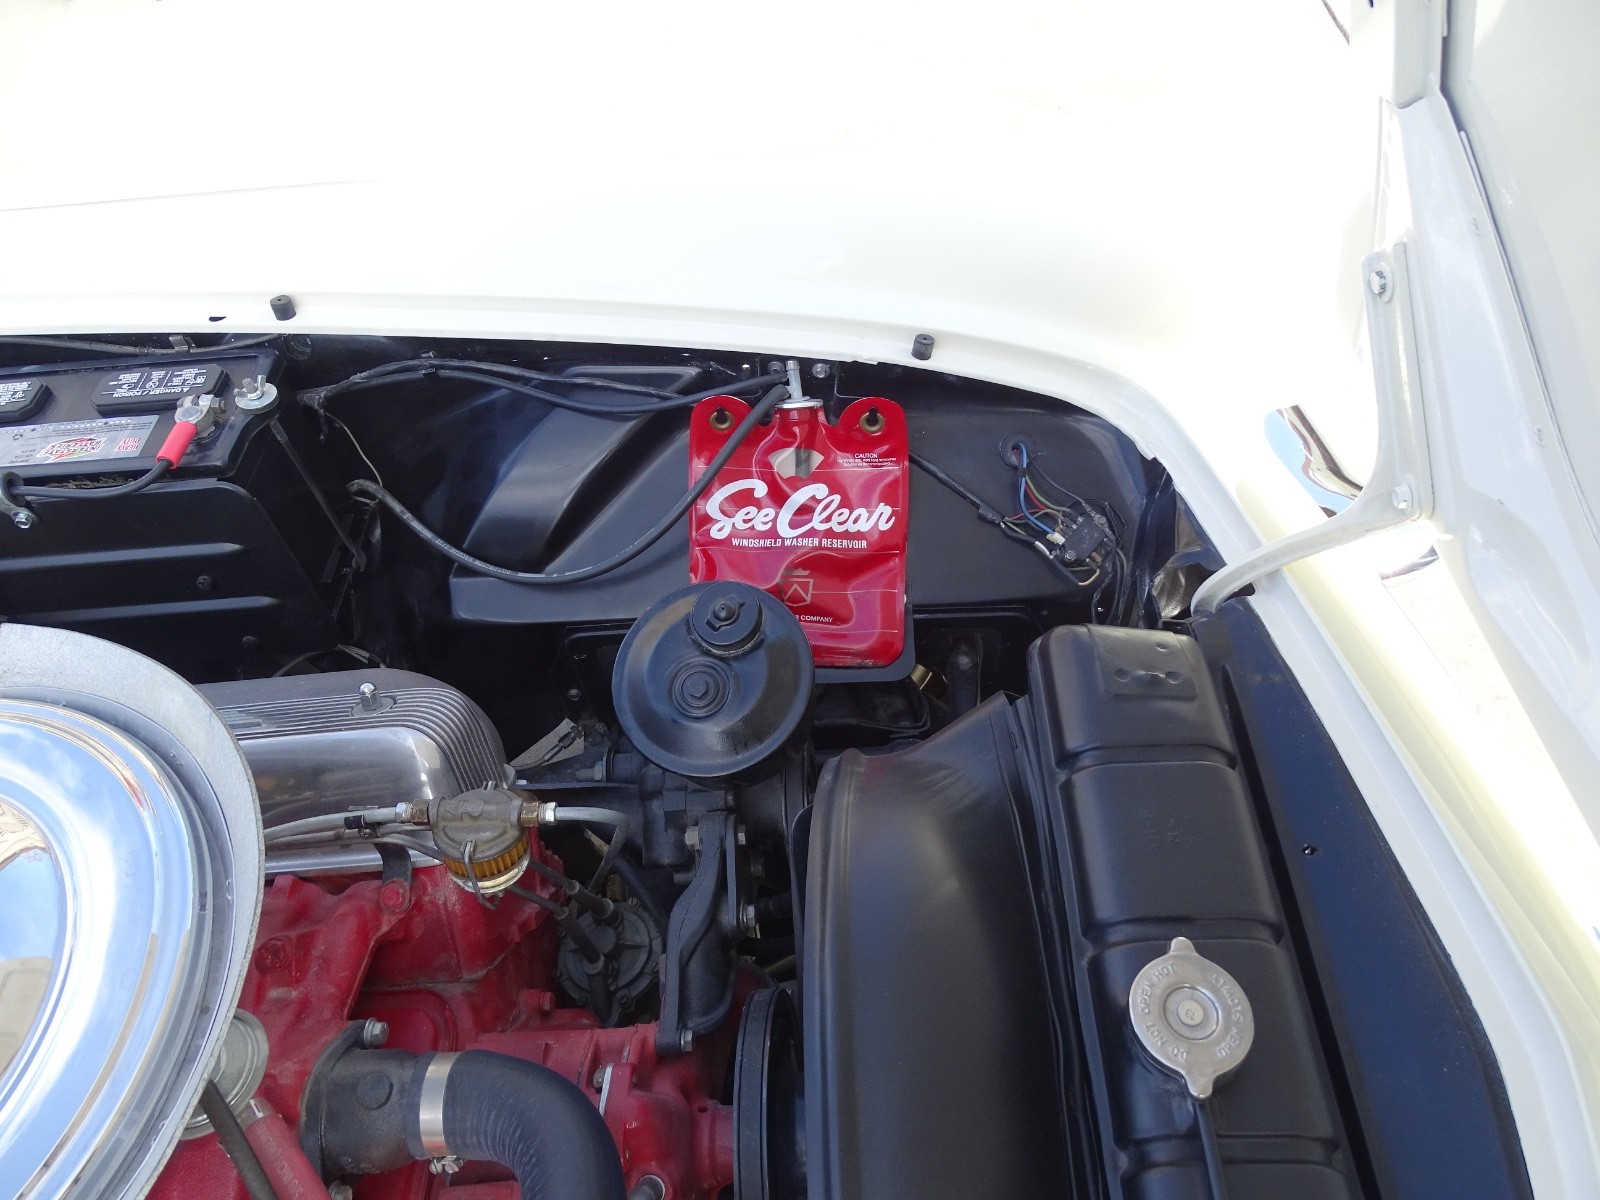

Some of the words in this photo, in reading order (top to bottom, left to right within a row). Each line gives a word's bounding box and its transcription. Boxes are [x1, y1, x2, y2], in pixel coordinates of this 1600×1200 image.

[45, 445, 101, 455] INTERSTATE
[706, 478, 775, 539] See
[776, 483, 895, 538] Clear
[731, 537, 782, 548] WINDSHIELD
[784, 537, 819, 547] WASHER
[821, 538, 867, 549] RESERVOIR
[1154, 961, 1176, 982] HOT
[1139, 982, 1155, 1016] OPEN
[1145, 1022, 1168, 1049] NOT
